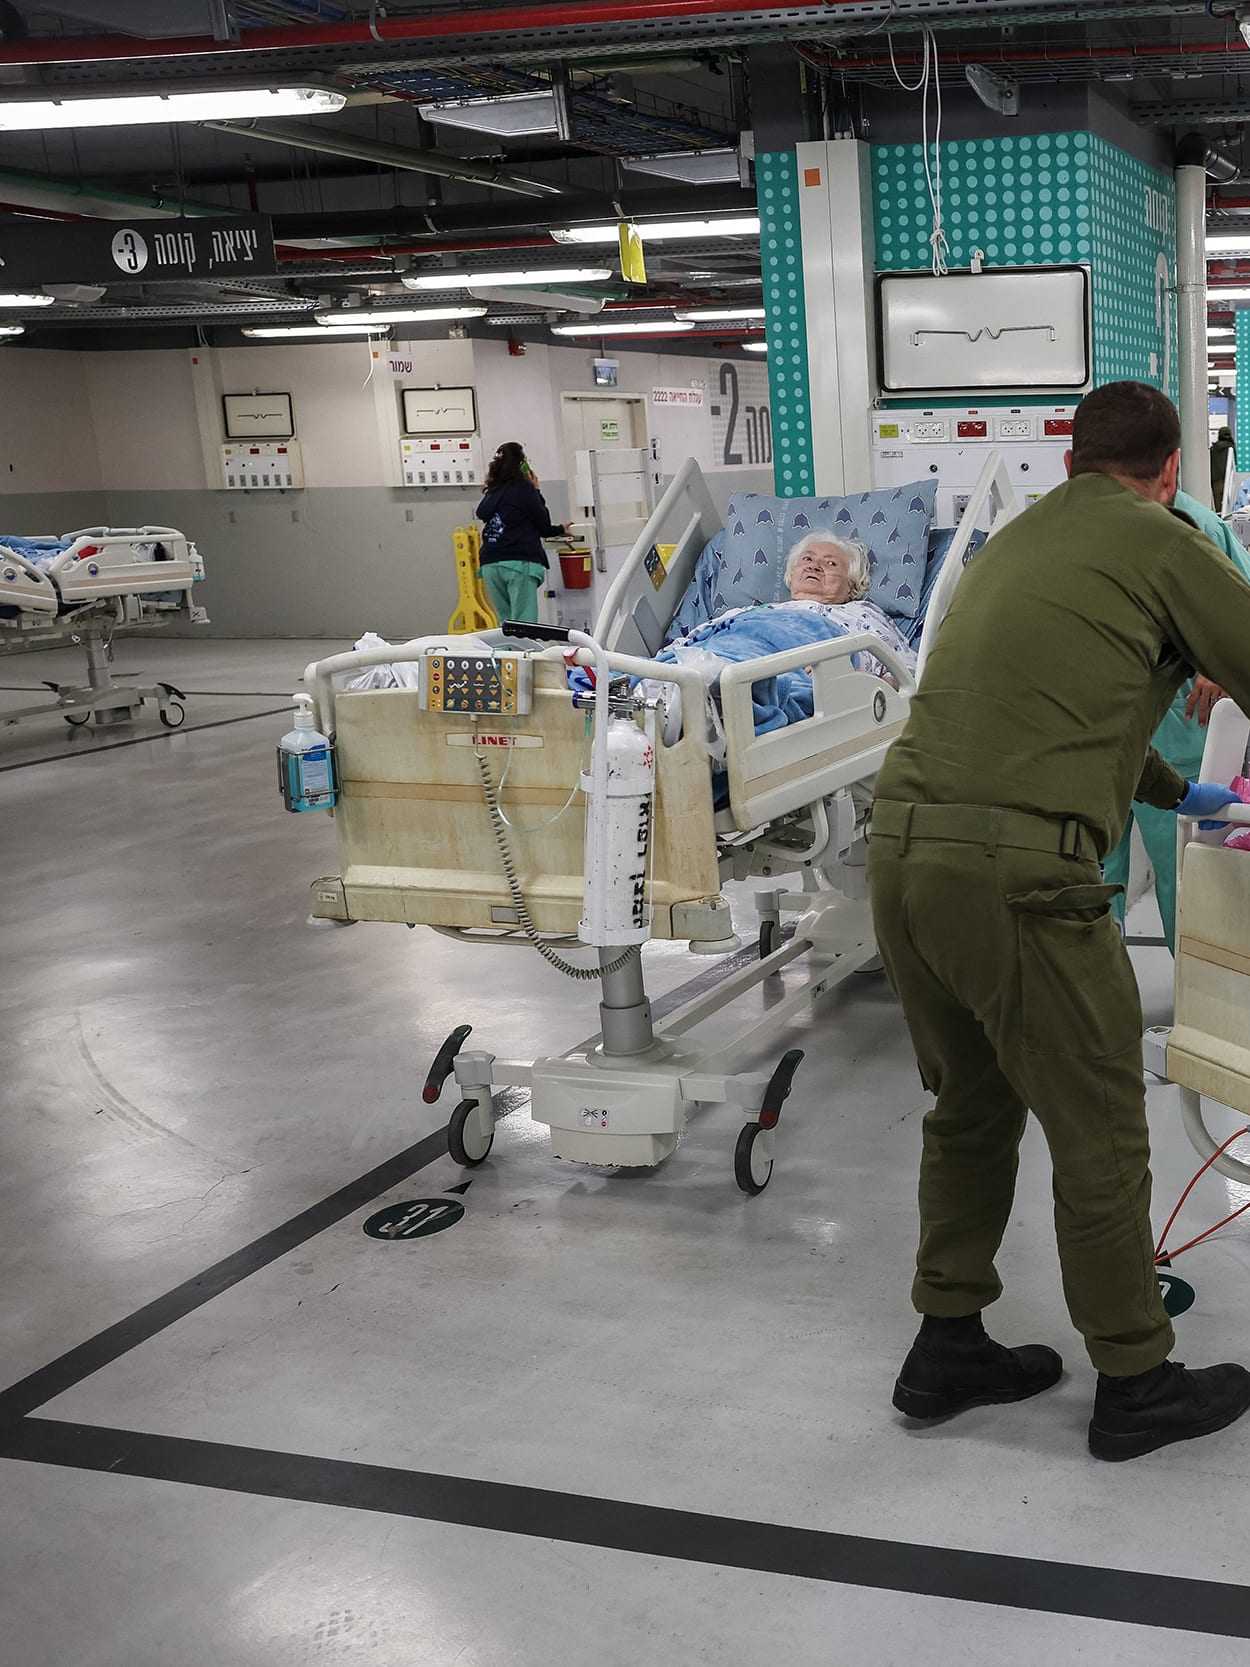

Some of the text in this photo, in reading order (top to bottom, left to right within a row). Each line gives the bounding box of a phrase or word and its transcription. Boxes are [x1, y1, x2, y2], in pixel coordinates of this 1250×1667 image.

[1143, 185, 1168, 246] קומה
[118, 229, 258, 273] יציאה, קומה -3
[389, 360, 413, 373] שמור
[652, 390, 668, 402] 2222
[711, 362, 743, 465] -2
[471, 735, 518, 746] LINET
[378, 1203, 449, 1236] 31
